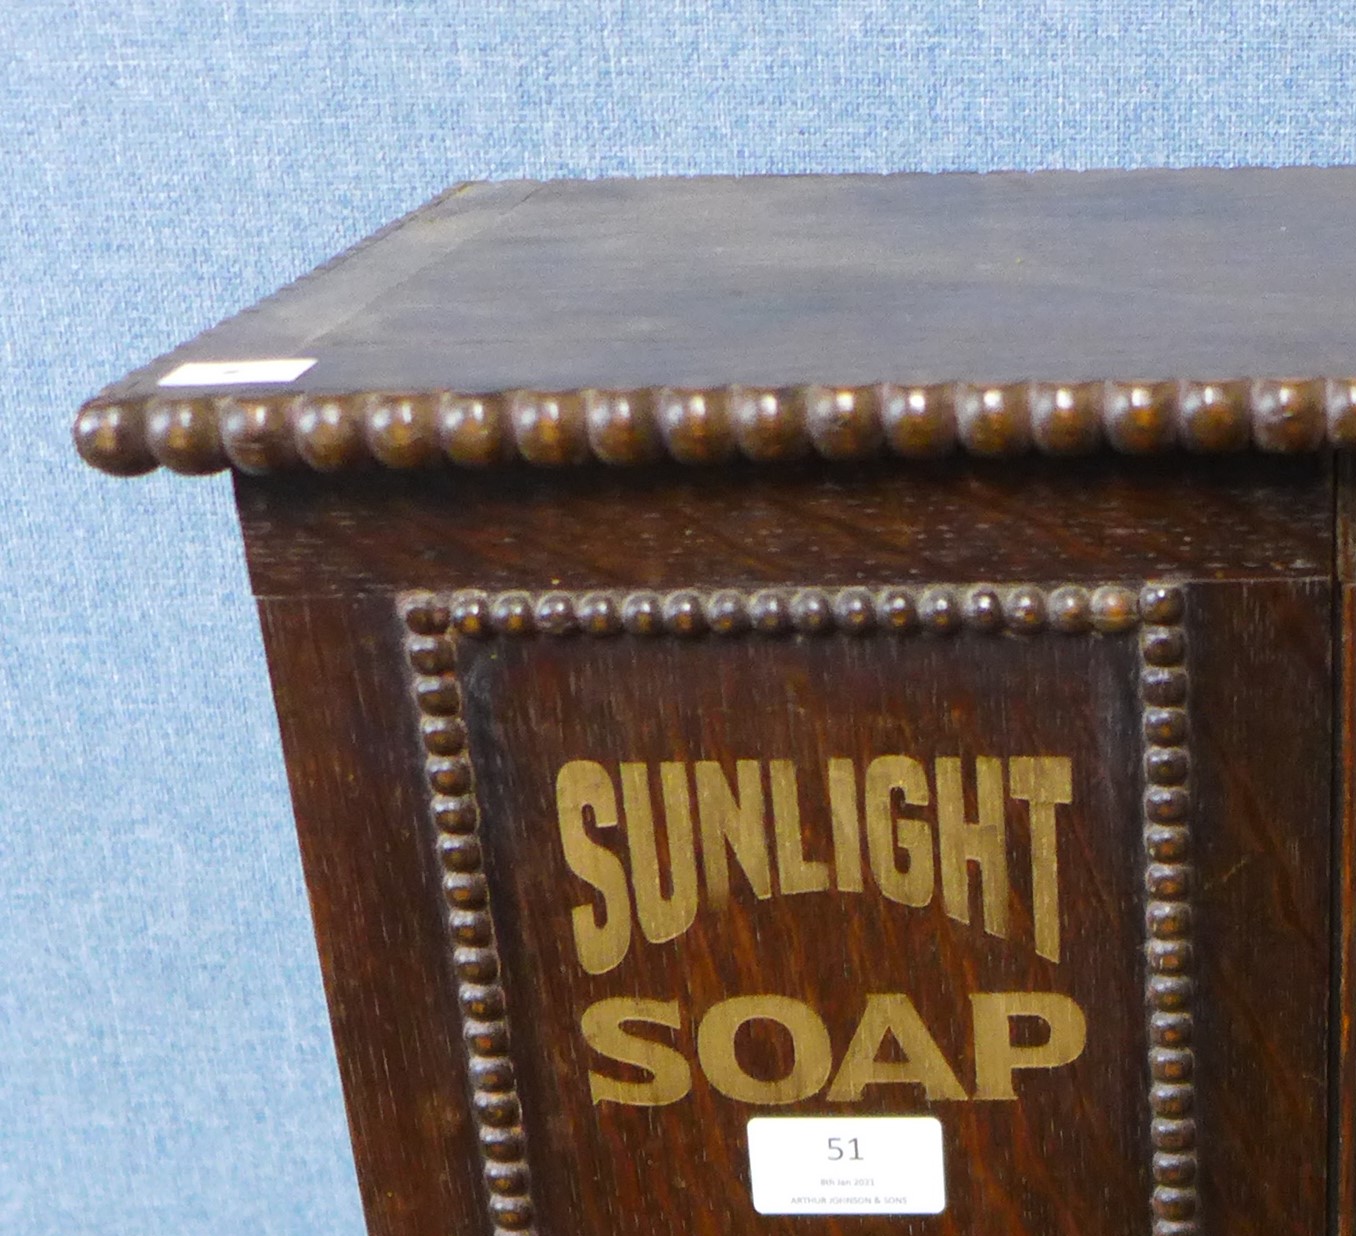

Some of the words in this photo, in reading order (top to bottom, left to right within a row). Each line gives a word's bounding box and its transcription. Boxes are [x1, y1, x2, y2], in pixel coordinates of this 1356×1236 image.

[556, 753, 1072, 976] SUNLIGHT
[580, 992, 1087, 1107] SOAP
[827, 1137, 864, 1161] 51
